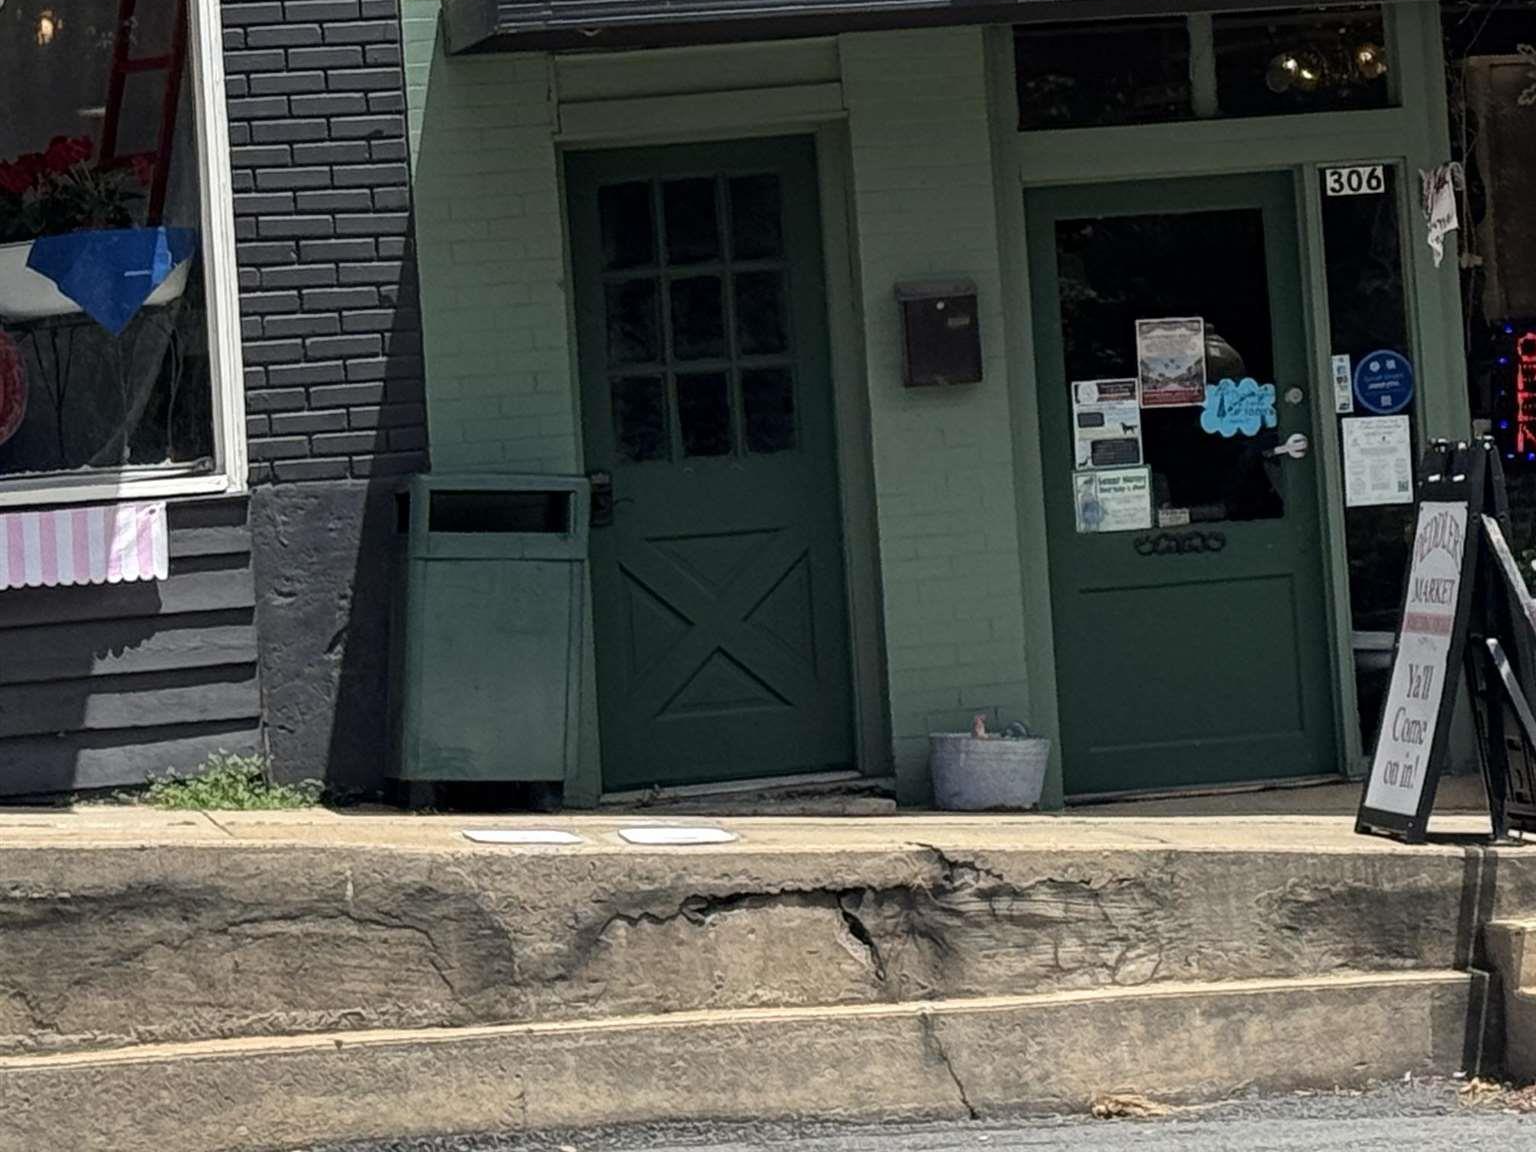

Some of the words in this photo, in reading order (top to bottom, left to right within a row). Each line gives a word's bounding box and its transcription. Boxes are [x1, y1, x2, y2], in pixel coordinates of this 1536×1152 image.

[1329, 167, 1383, 194] 306
[1410, 576, 1456, 605] MARKET
[1391, 706, 1428, 745] Come
[1382, 759, 1399, 786] on
[1399, 752, 1421, 790] in!
